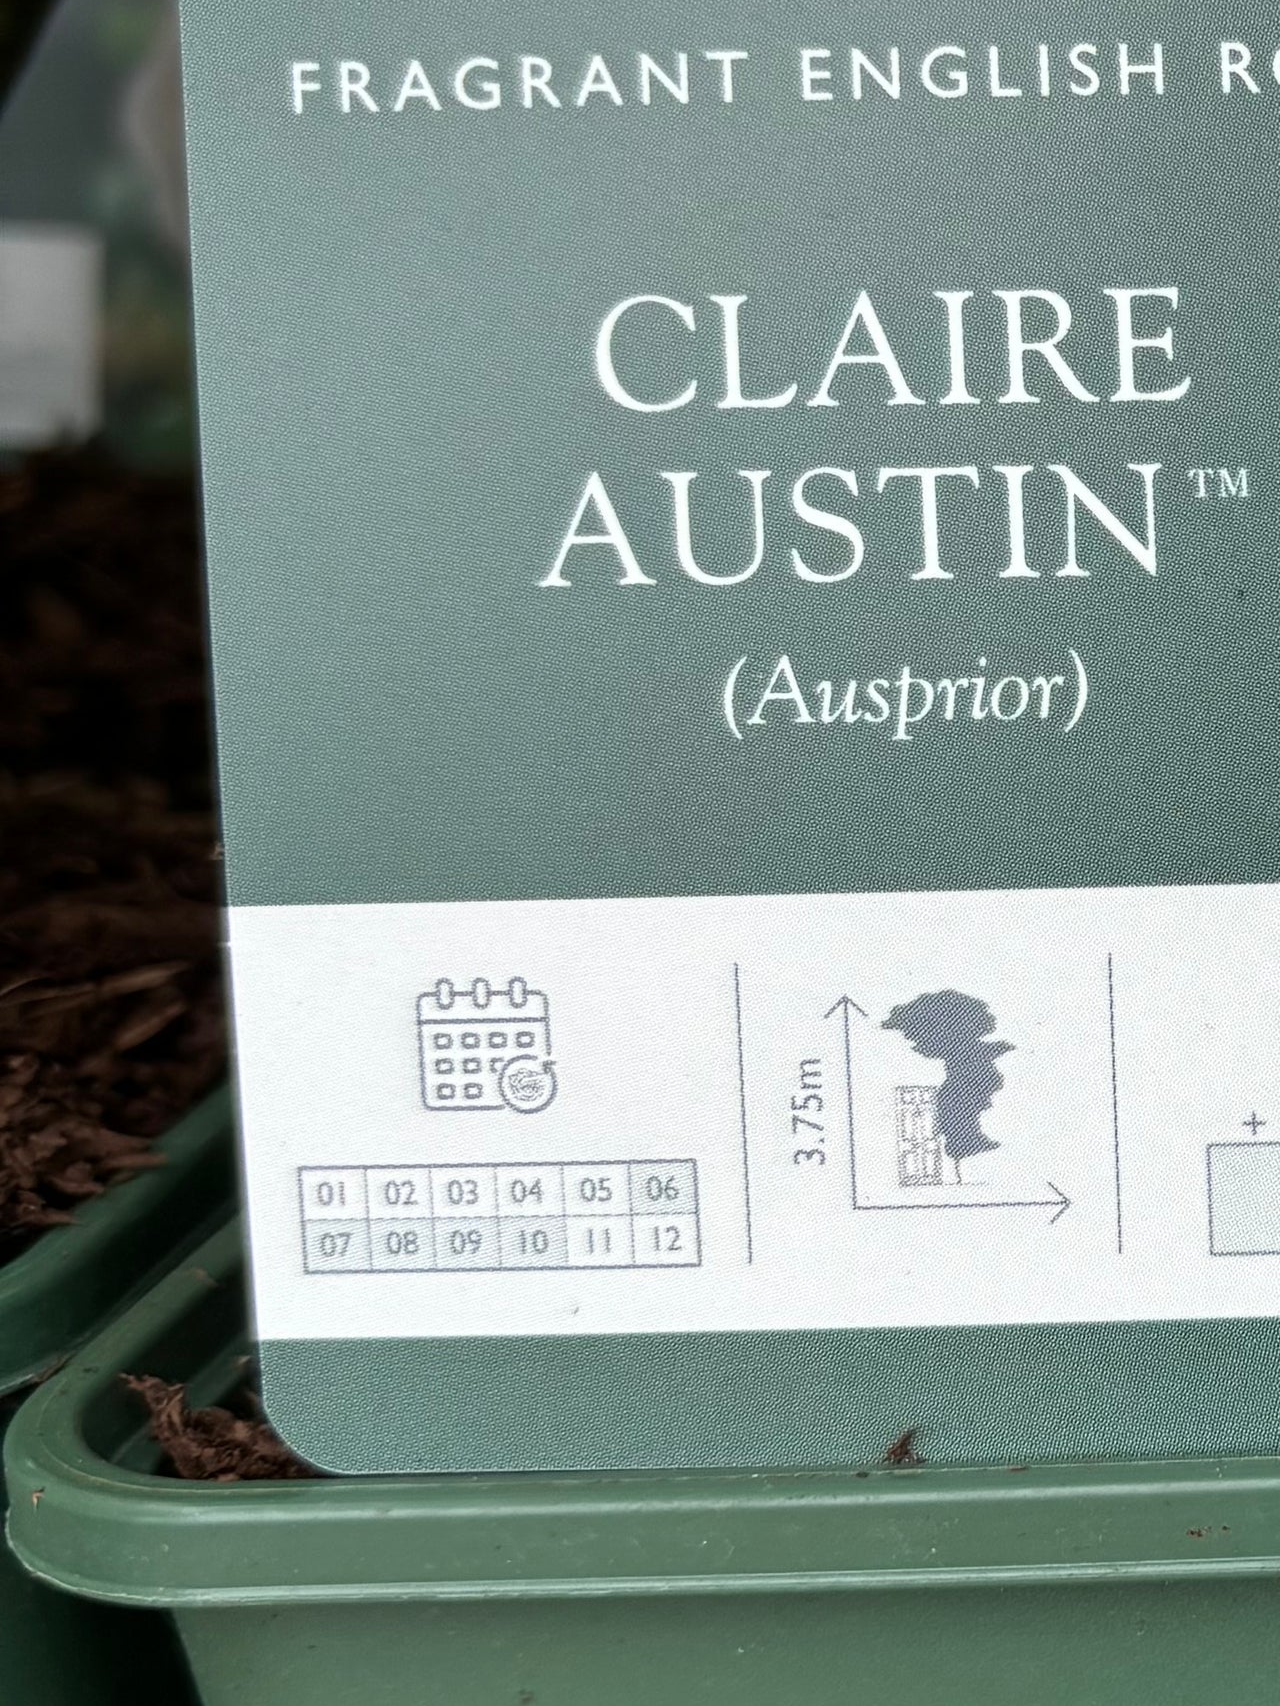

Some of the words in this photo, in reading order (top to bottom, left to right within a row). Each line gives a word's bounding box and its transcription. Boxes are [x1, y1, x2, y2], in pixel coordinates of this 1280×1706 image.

[288, 47, 750, 116] FRAGRANT
[797, 40, 1166, 103] ENGLISH
[591, 284, 1193, 415] CLAIRE
[718, 648, 1091, 743] (Ausprior)
[788, 1055, 828, 1168] 3.75m
[315, 1180, 347, 1208] 01
[382, 1178, 418, 1207] 02
[445, 1178, 480, 1207] 03
[508, 1177, 544, 1205] 04
[577, 1176, 614, 1204] 05
[644, 1174, 681, 1203] 06
[318, 1230, 354, 1259] 07
[384, 1229, 420, 1257] 08
[448, 1228, 484, 1257] 09
[517, 1227, 551, 1256] 10
[584, 1225, 613, 1254] 11
[652, 1223, 683, 1254] 12
